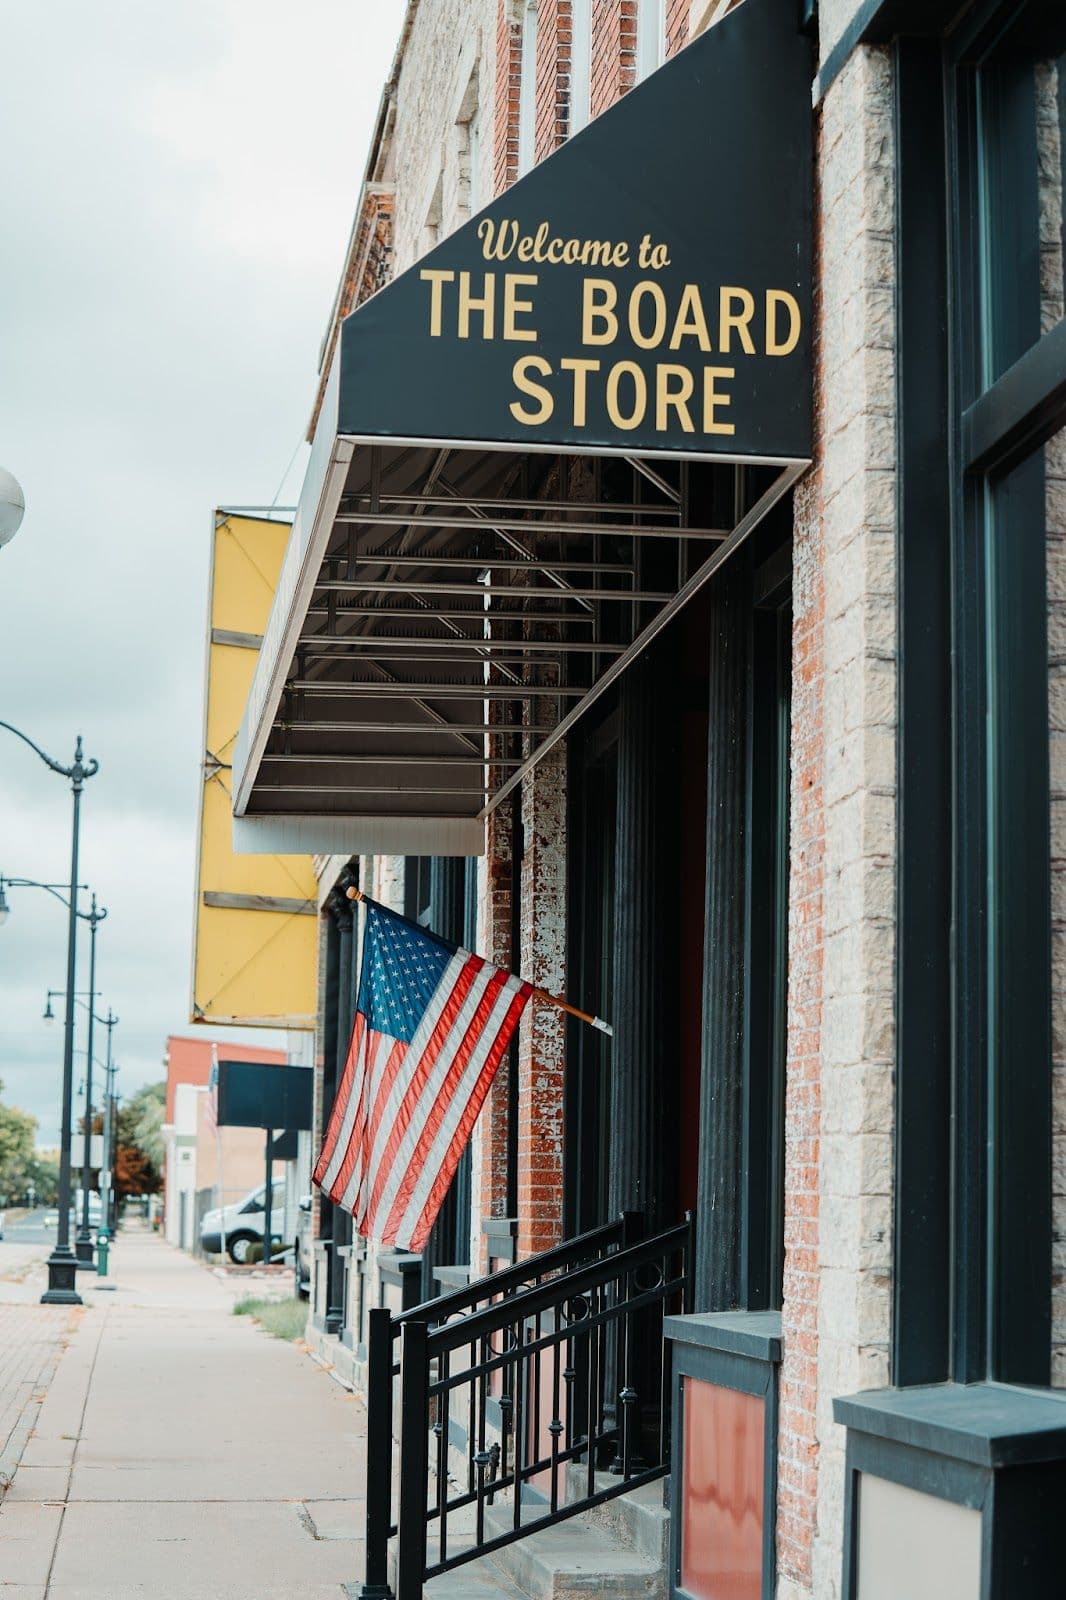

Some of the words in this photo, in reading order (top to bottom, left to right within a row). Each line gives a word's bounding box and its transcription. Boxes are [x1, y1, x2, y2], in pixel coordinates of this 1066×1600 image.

[477, 219, 629, 267] Welcome
[639, 234, 670, 269] to
[420, 269, 538, 341] THE
[582, 278, 801, 356] BOARD
[509, 355, 735, 435] STORE
